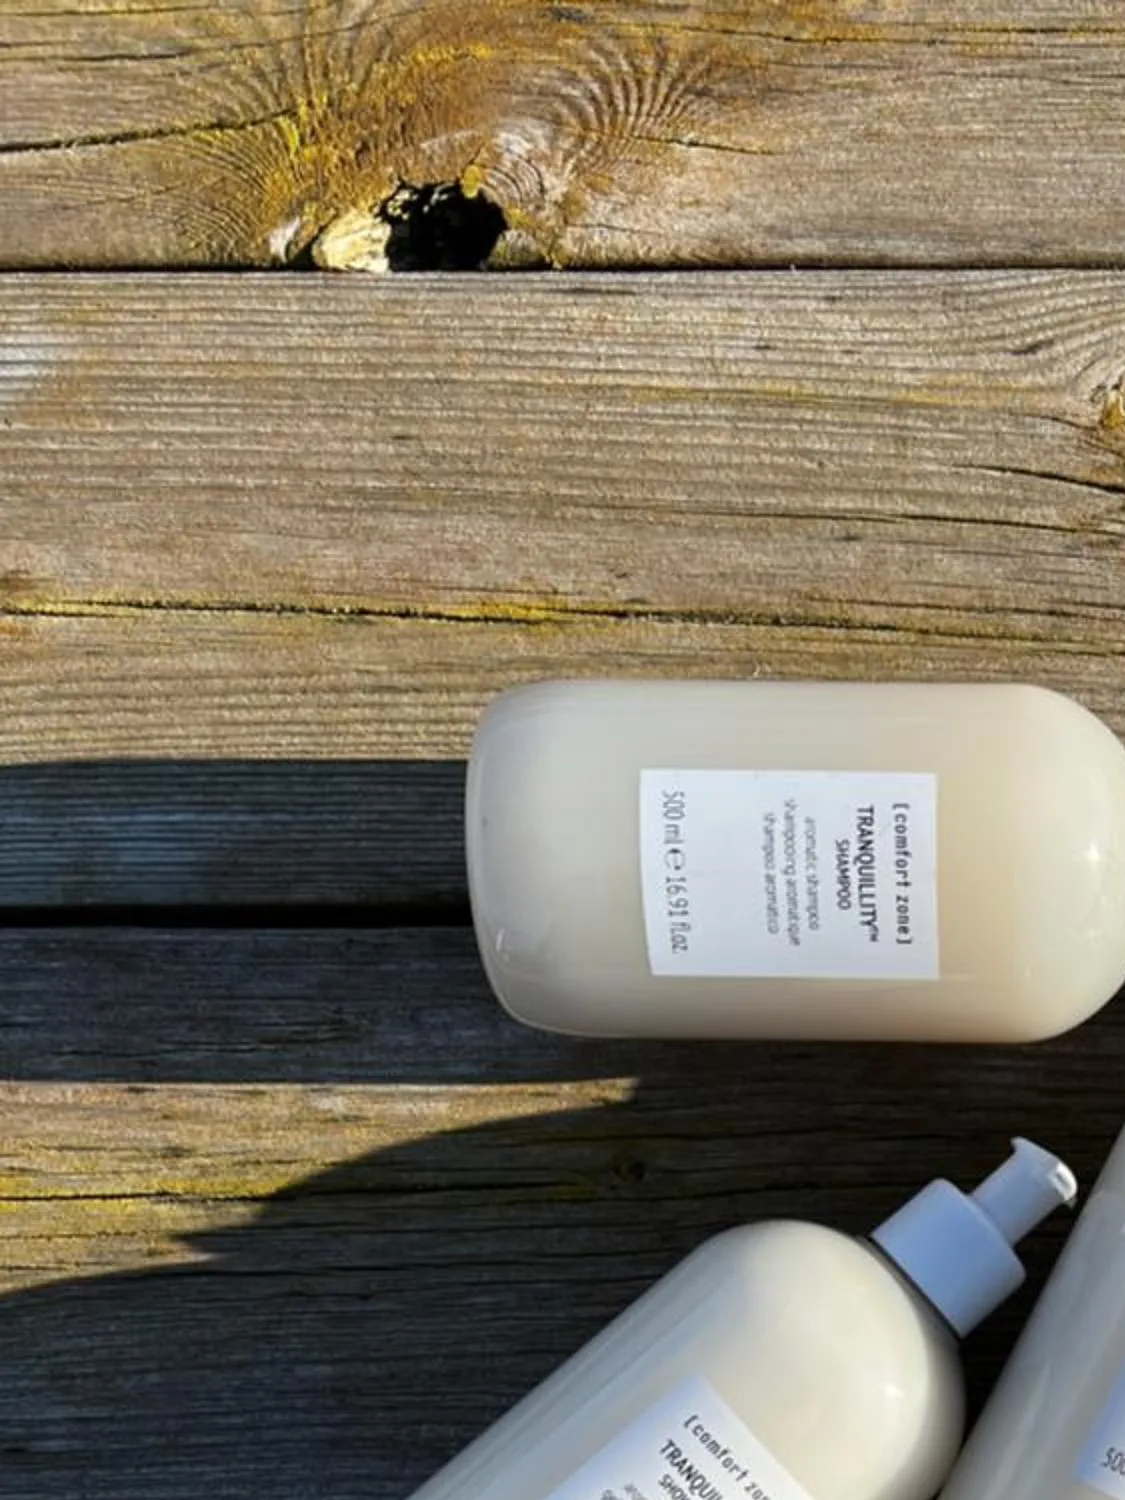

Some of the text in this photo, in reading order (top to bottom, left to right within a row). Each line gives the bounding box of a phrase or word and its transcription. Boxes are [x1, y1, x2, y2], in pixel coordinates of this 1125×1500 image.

[661, 790, 686, 820] 500
[662, 824, 683, 844] ml
[835, 839, 851, 909] SHAMPOO
[892, 802, 912, 944] [comfort zone]
